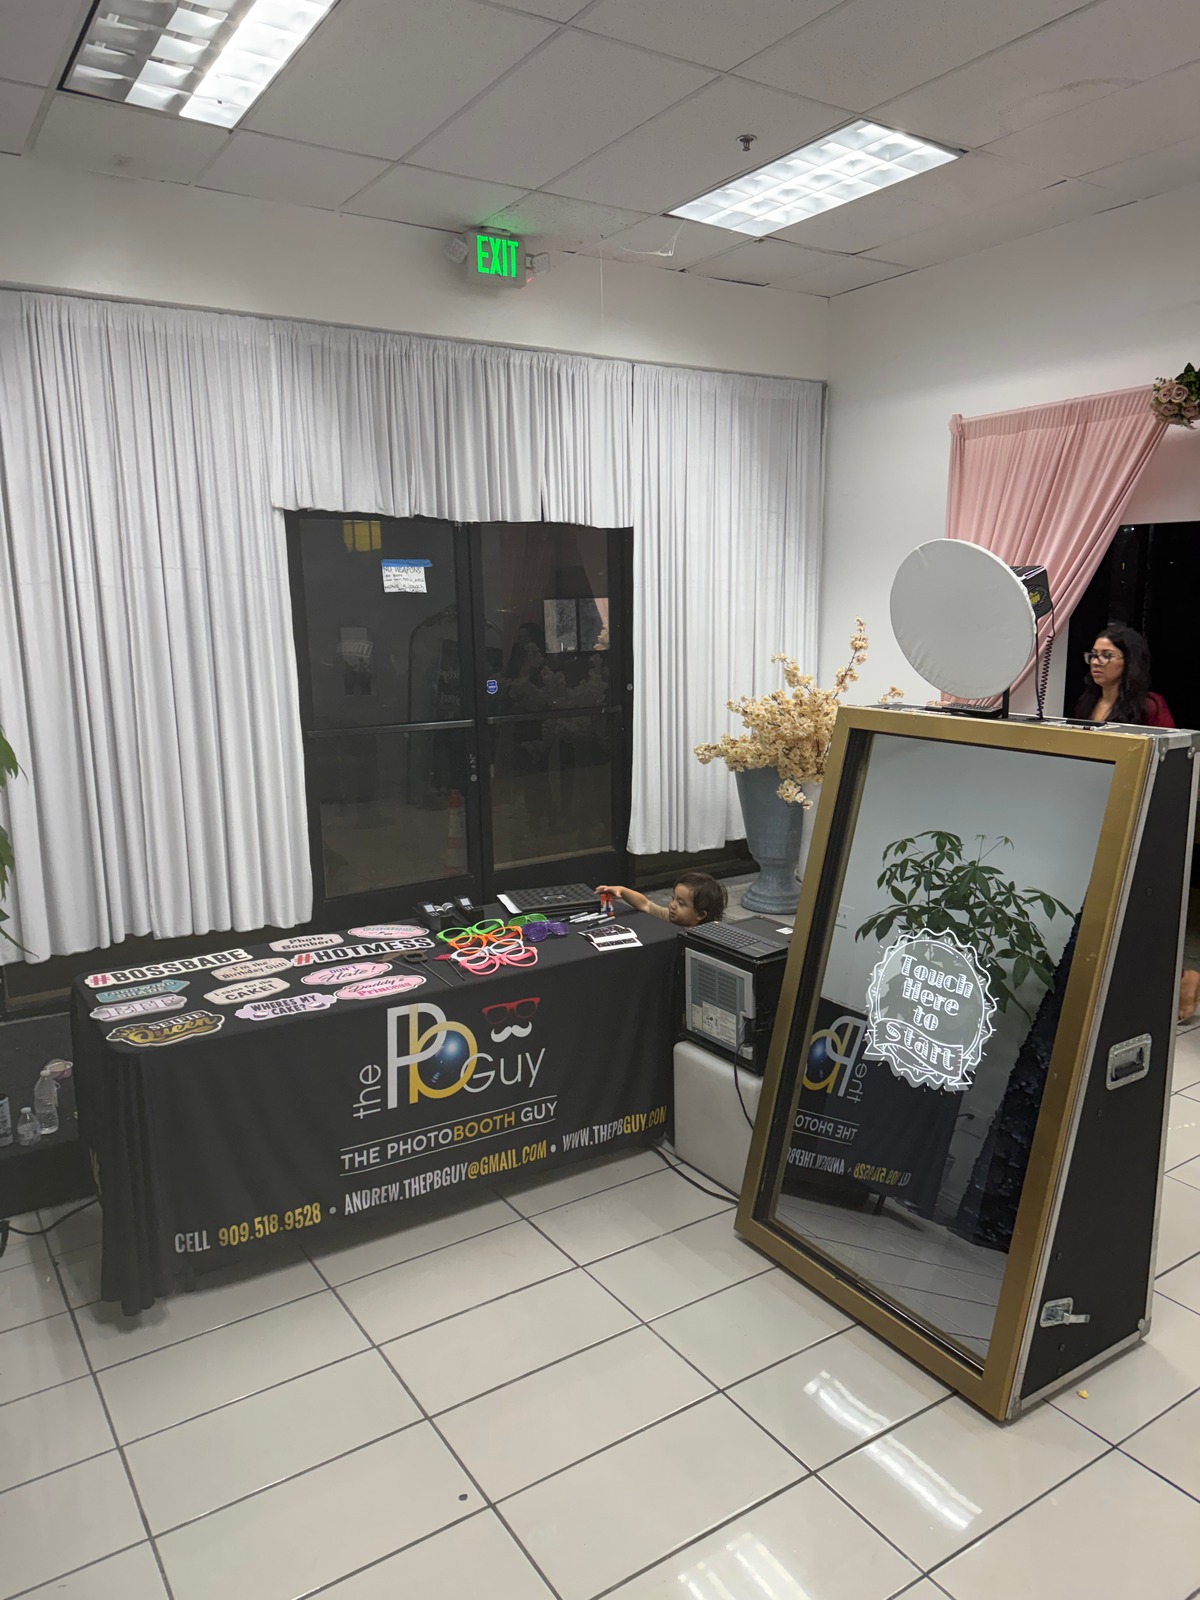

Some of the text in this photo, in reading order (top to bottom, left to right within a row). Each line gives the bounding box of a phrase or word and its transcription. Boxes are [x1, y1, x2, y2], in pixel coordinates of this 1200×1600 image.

[477, 235, 519, 278] EXIT
[282, 939, 333, 951] Bomber!
[289, 936, 324, 945] Photo
[295, 938, 432, 965] #HOTMESS
[91, 950, 248, 986] #BOSSBABE
[221, 967, 264, 979] Birthday
[901, 954, 974, 998] Touch
[221, 987, 243, 995] came
[225, 984, 277, 1001] CAKE!
[348, 977, 405, 993] Daddy's
[357, 982, 412, 997] Princess
[902, 977, 959, 1016] Here
[251, 995, 317, 1012] WHERES MY
[271, 1004, 307, 1015] CAKE?
[128, 1016, 219, 1043] Queen
[149, 1013, 205, 1030] SELFIE
[912, 1005, 939, 1031] to
[885, 1021, 956, 1071] Start
[353, 1064, 382, 1119] the
[340, 1100, 558, 1170] THE PHOTOBOOTH GUY
[174, 1230, 210, 1253] CELL
[218, 1202, 321, 1247] 909.518.9528
[344, 1139, 547, 1215] ANDREW.THEPBGUY@GMAIL.COM
